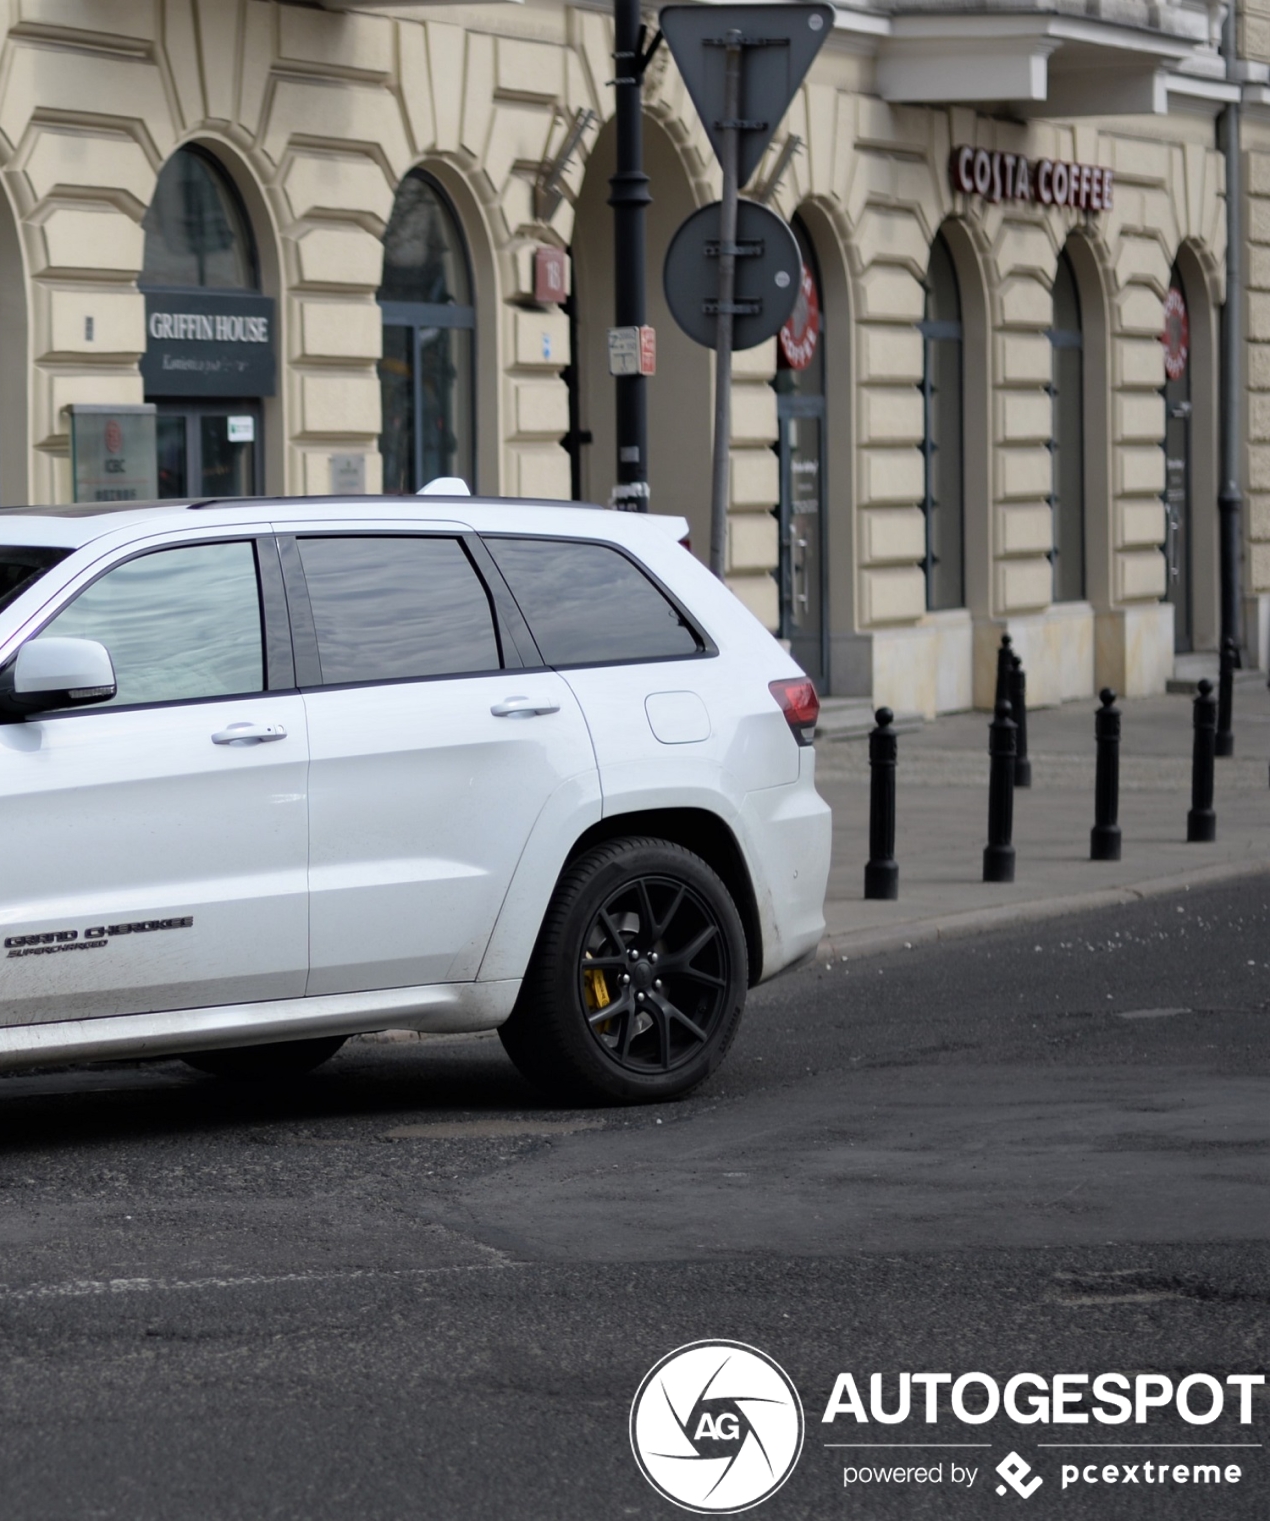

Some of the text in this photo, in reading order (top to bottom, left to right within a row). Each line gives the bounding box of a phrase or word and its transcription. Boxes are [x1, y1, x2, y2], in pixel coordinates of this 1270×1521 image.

[958, 147, 1114, 211] COSTA COFFEE
[150, 312, 269, 342] GRIFFIN HOUSE
[4, 916, 193, 948] GRAND CHEROKEE
[6, 939, 108, 958] SUPERCHARGED
